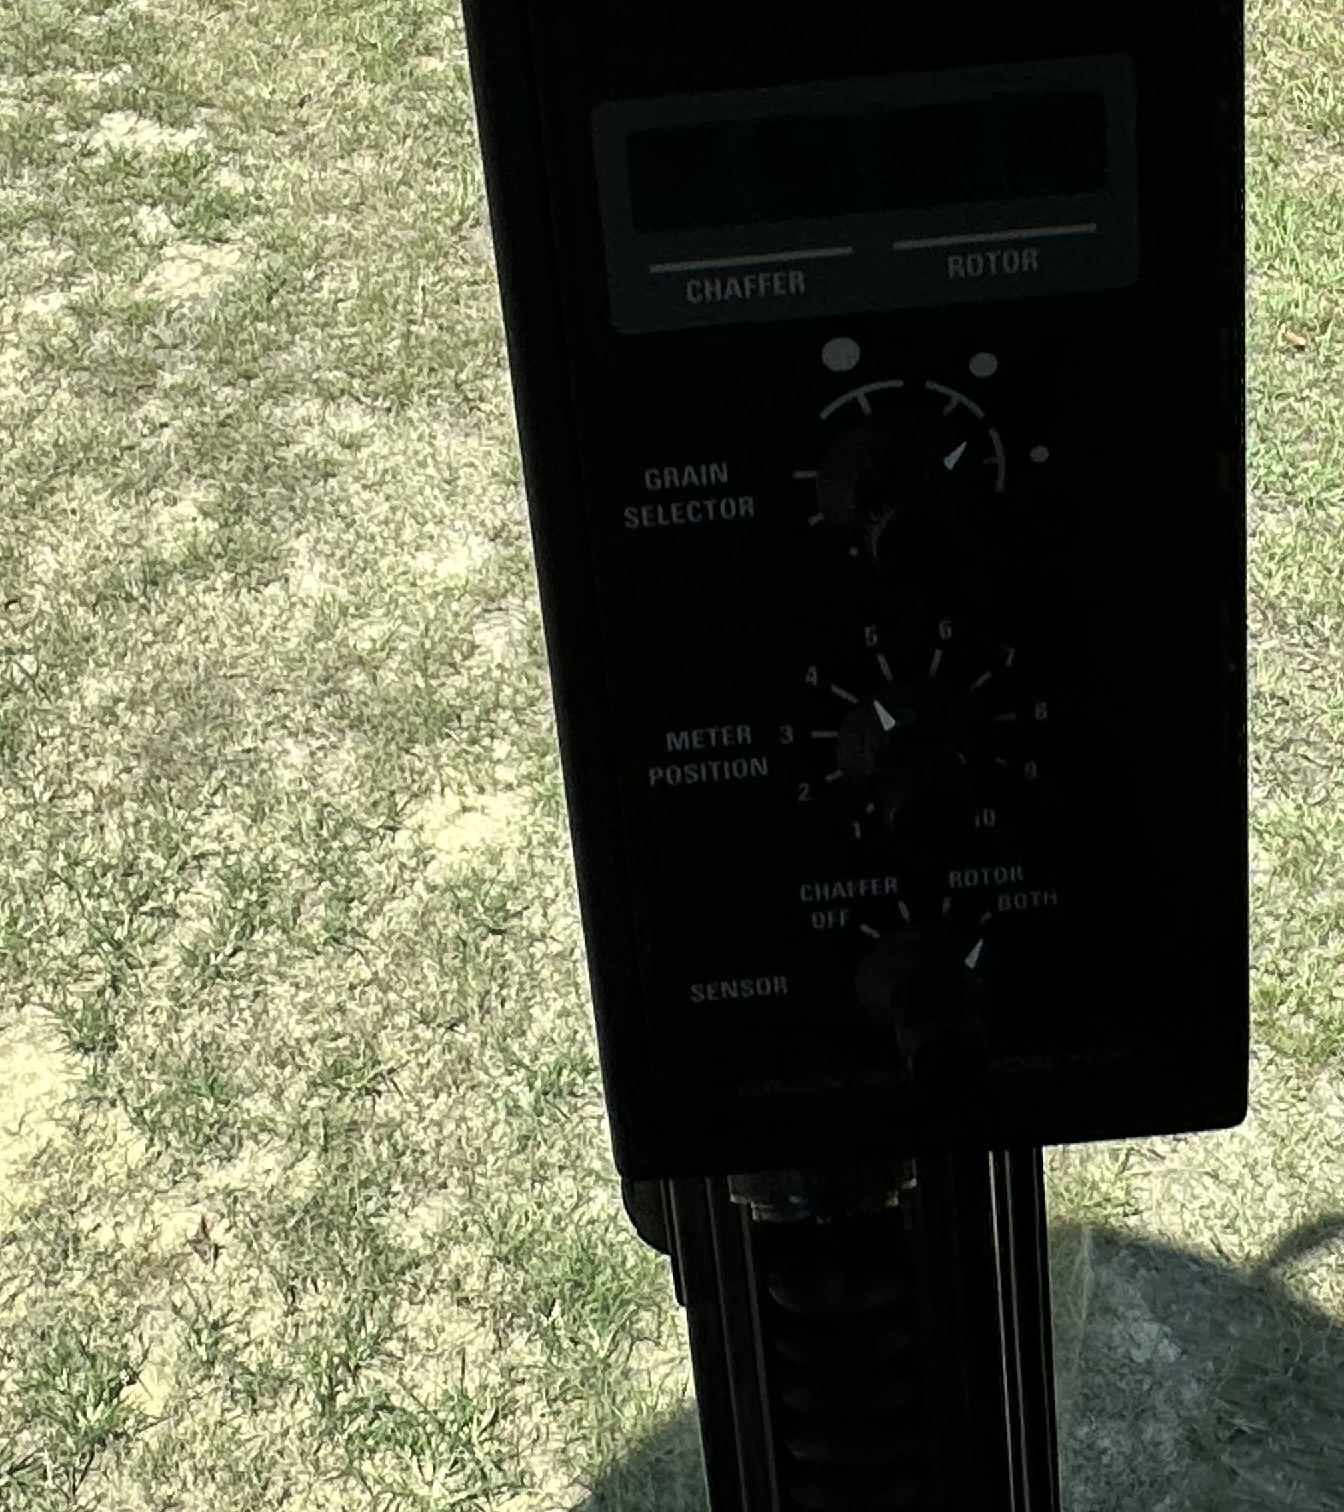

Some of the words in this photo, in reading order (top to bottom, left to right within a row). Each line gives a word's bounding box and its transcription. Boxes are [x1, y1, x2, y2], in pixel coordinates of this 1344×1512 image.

[946, 247, 1040, 280] ROTOR
[685, 268, 806, 306] CHAFFER
[644, 461, 729, 490] GRAIN
[623, 495, 756, 531] SELECTOR
[864, 624, 878, 648] 5
[938, 618, 953, 641] 6
[805, 663, 819, 686] 4
[666, 724, 752, 752] METER
[780, 723, 794, 745] 3
[648, 756, 769, 788] POSITION
[796, 782, 811, 803] 2
[799, 875, 899, 903] CHAFFER
[948, 865, 1024, 889] ROTOR
[997, 888, 1058, 913] BOTH
[811, 908, 850, 930] OFF
[689, 974, 789, 1003] SENSOR
